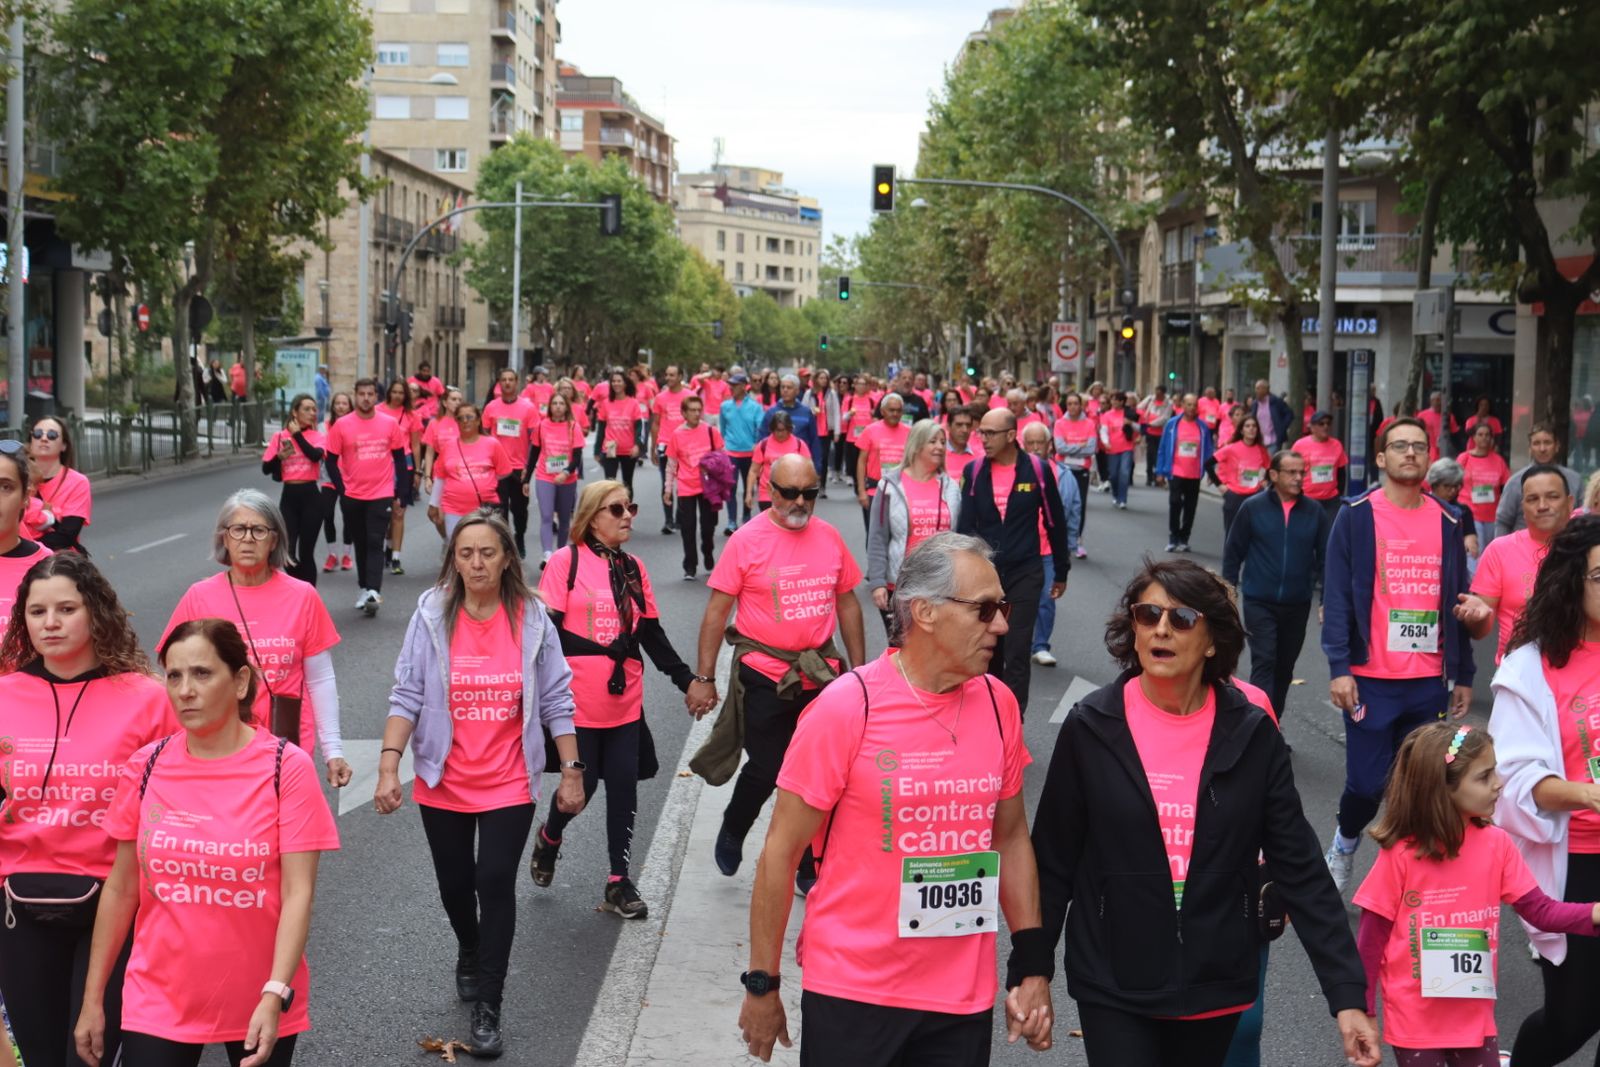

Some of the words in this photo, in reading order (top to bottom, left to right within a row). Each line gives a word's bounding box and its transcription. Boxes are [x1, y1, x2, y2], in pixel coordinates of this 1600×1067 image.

[1386, 552, 1400, 563] En
[1387, 566, 1430, 579] contra
[779, 579, 795, 591] En
[781, 589, 827, 606] contra
[595, 601, 612, 613] En
[1400, 624, 1428, 638] 2634
[281, 651, 294, 665] el
[451, 671, 471, 685] En
[452, 687, 513, 702] contra
[13, 760, 37, 777] En
[13, 782, 97, 802] contra
[899, 777, 928, 796] En
[881, 778, 893, 852] SALAMANCA
[898, 800, 983, 823] contra
[151, 830, 177, 850] En
[183, 839, 270, 857] marcha
[898, 824, 992, 853] cánce
[149, 859, 237, 882] contra
[241, 861, 266, 882] el
[154, 877, 267, 908] cáncer
[918, 881, 983, 909] 10936
[1421, 912, 1445, 929] En
[1408, 914, 1420, 979] SALAMANCA
[1450, 953, 1482, 974] 162
